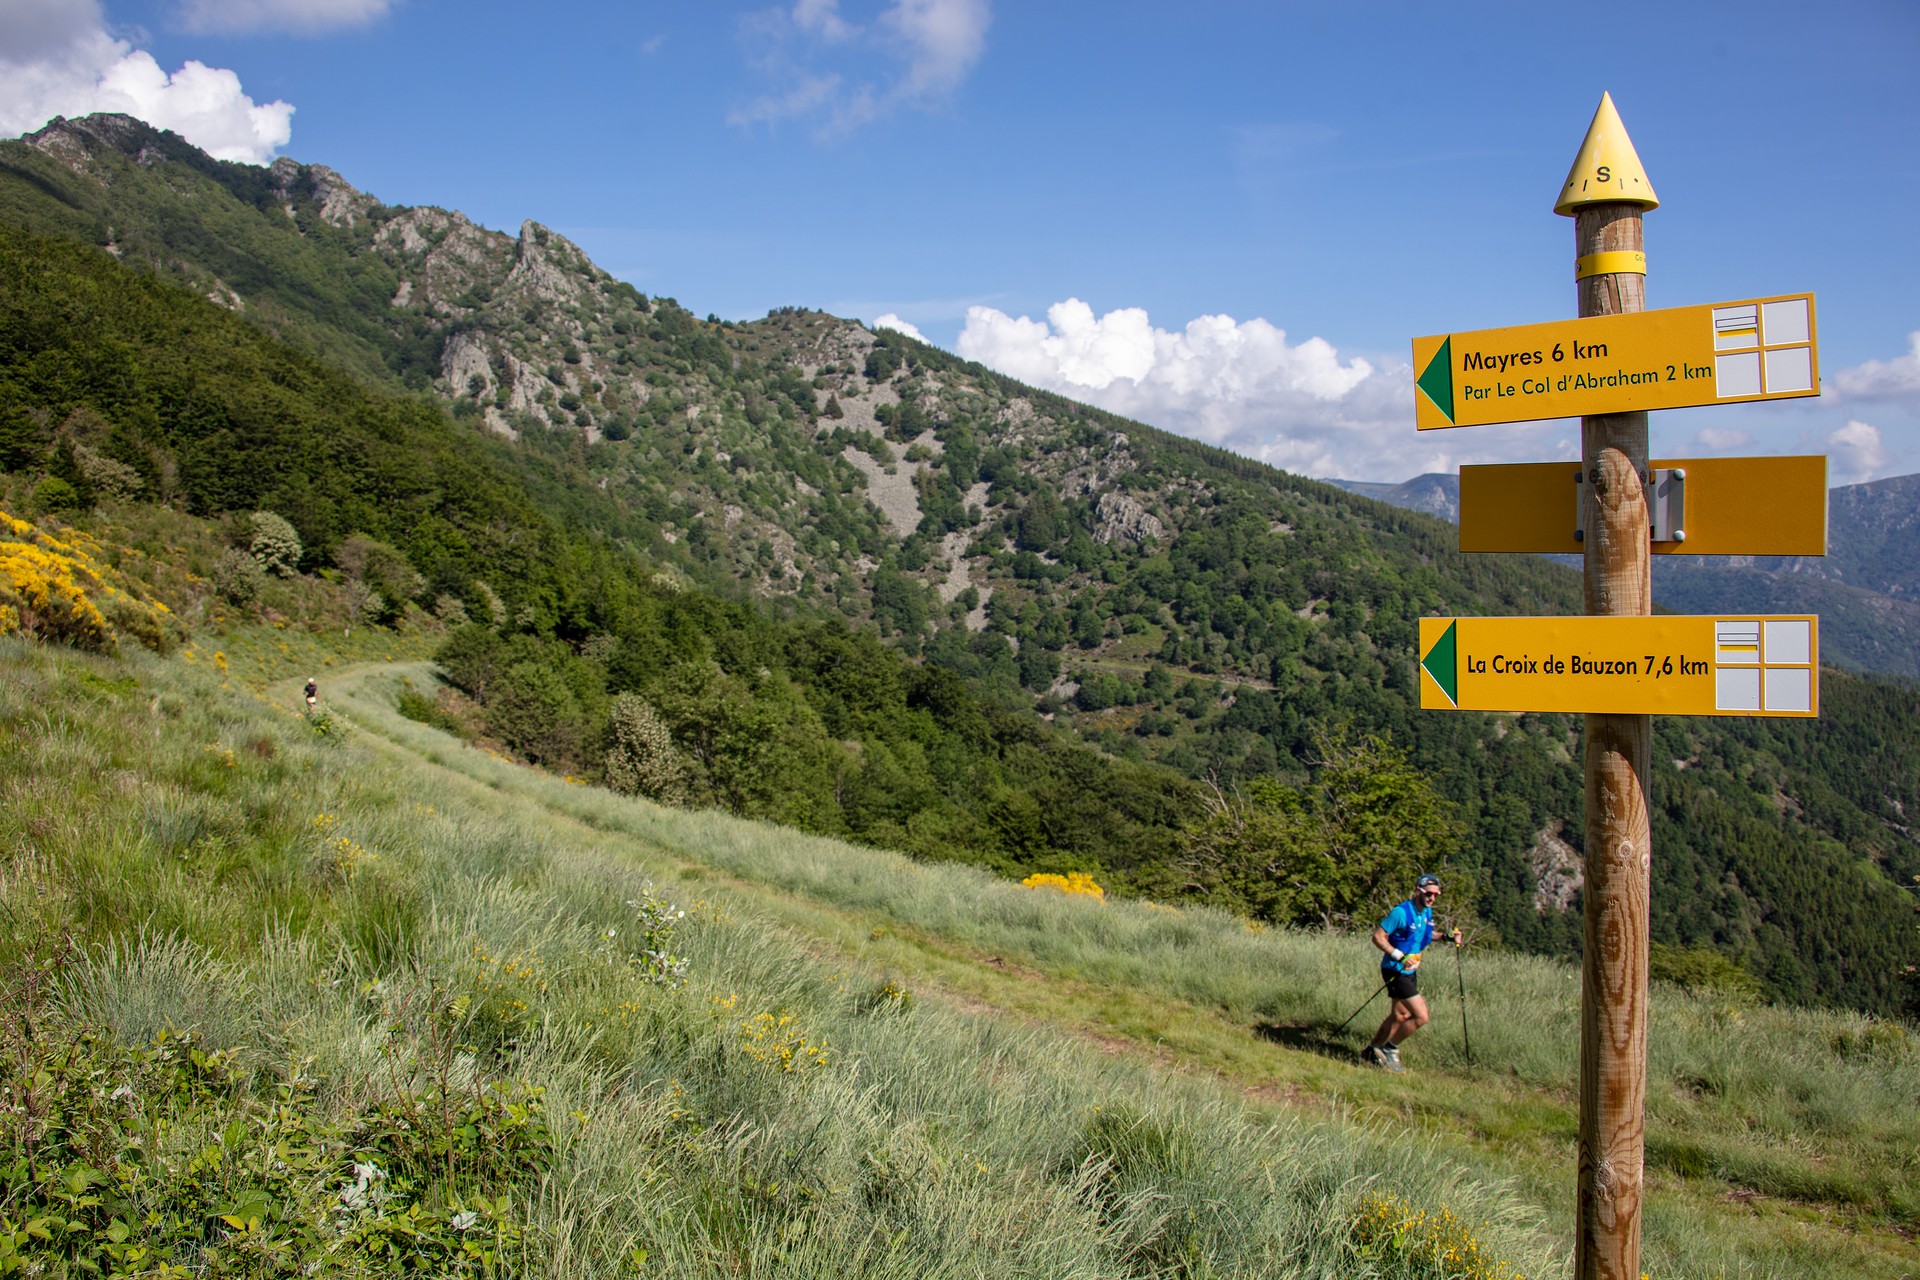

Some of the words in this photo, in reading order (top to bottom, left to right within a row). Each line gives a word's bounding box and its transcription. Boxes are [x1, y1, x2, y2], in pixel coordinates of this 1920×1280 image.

[1463, 350, 1543, 373] Mayres
[1551, 343, 1565, 363] 6
[1573, 339, 1608, 360] km
[1463, 384, 1492, 401] Par
[1497, 382, 1516, 397] Le
[1522, 376, 1551, 395] Col
[1665, 365, 1677, 381] 2
[1683, 362, 1712, 380] km
[1467, 654, 1486, 674] La
[1492, 654, 1538, 674] Croix
[1543, 654, 1565, 675] de
[1571, 655, 1637, 675] Bauzon
[1644, 655, 1673, 679] 7,6
[1680, 654, 1709, 676] km
